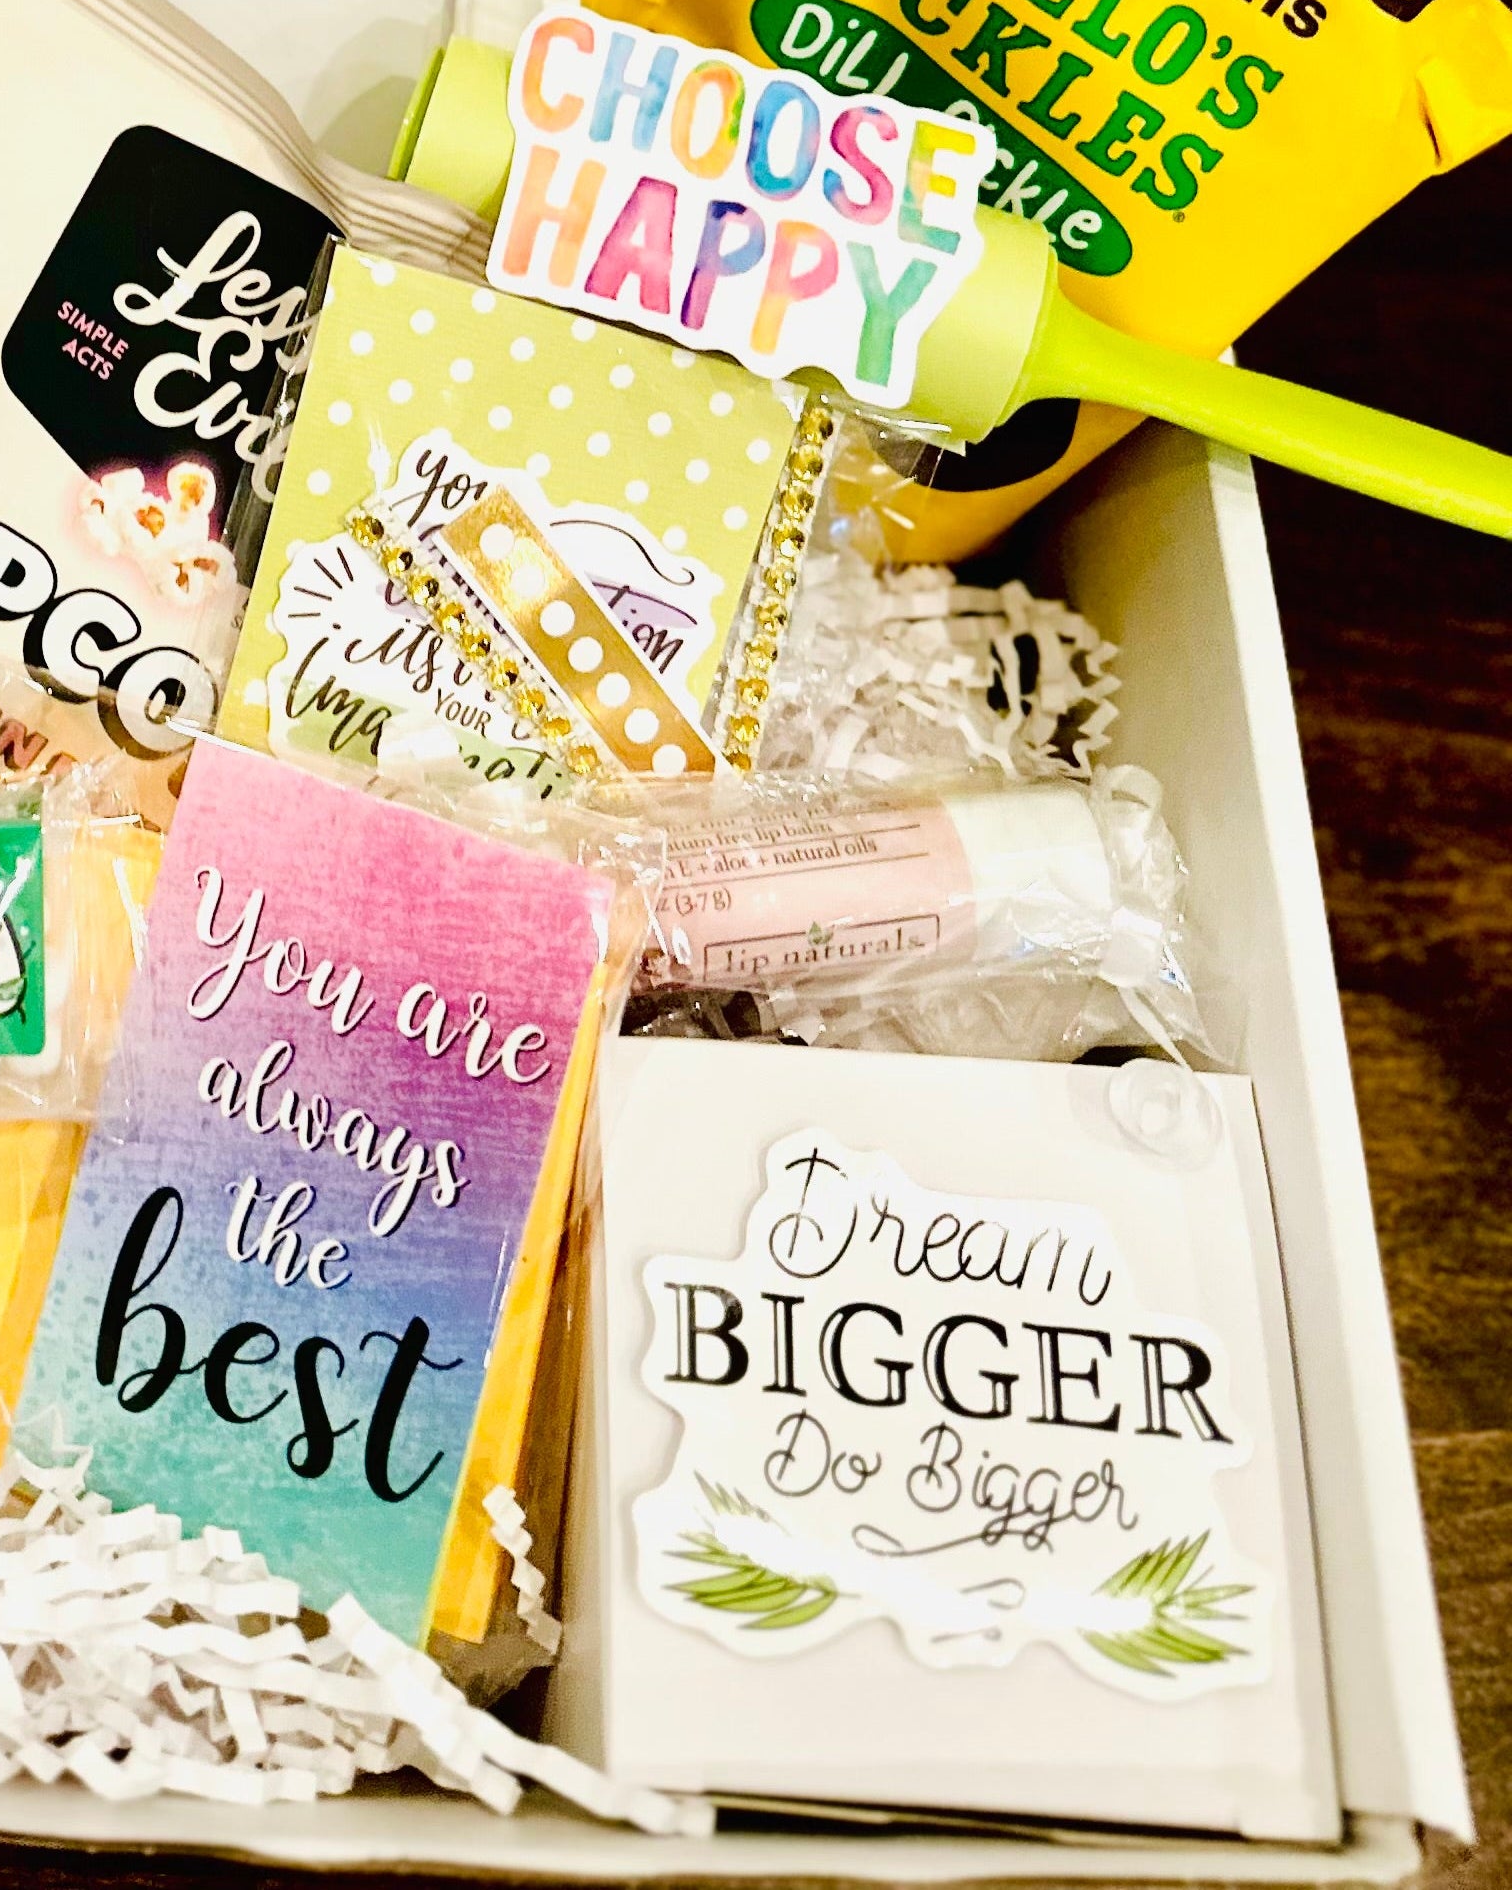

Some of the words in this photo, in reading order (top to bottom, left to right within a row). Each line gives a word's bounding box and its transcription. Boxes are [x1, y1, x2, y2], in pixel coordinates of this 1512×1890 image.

[520, 17, 977, 255] CHOOSE
[57, 300, 130, 361] SIMPLE
[500, 144, 938, 388] HAPPY
[61, 338, 115, 381] ACTS
[434, 686, 493, 739] YOUR
[773, 838, 842, 865] natural
[844, 833, 878, 856] oils
[186, 864, 376, 1038] You
[395, 981, 551, 1085] are
[725, 948, 770, 974] lip
[197, 1039, 472, 1238] always
[223, 1174, 353, 1290] the
[768, 1146, 1112, 1307] Dream
[94, 1184, 467, 1504] best
[661, 1281, 1235, 1445] BIGGER
[763, 1408, 882, 1498] Do
[905, 1418, 1139, 1555] Bigger
